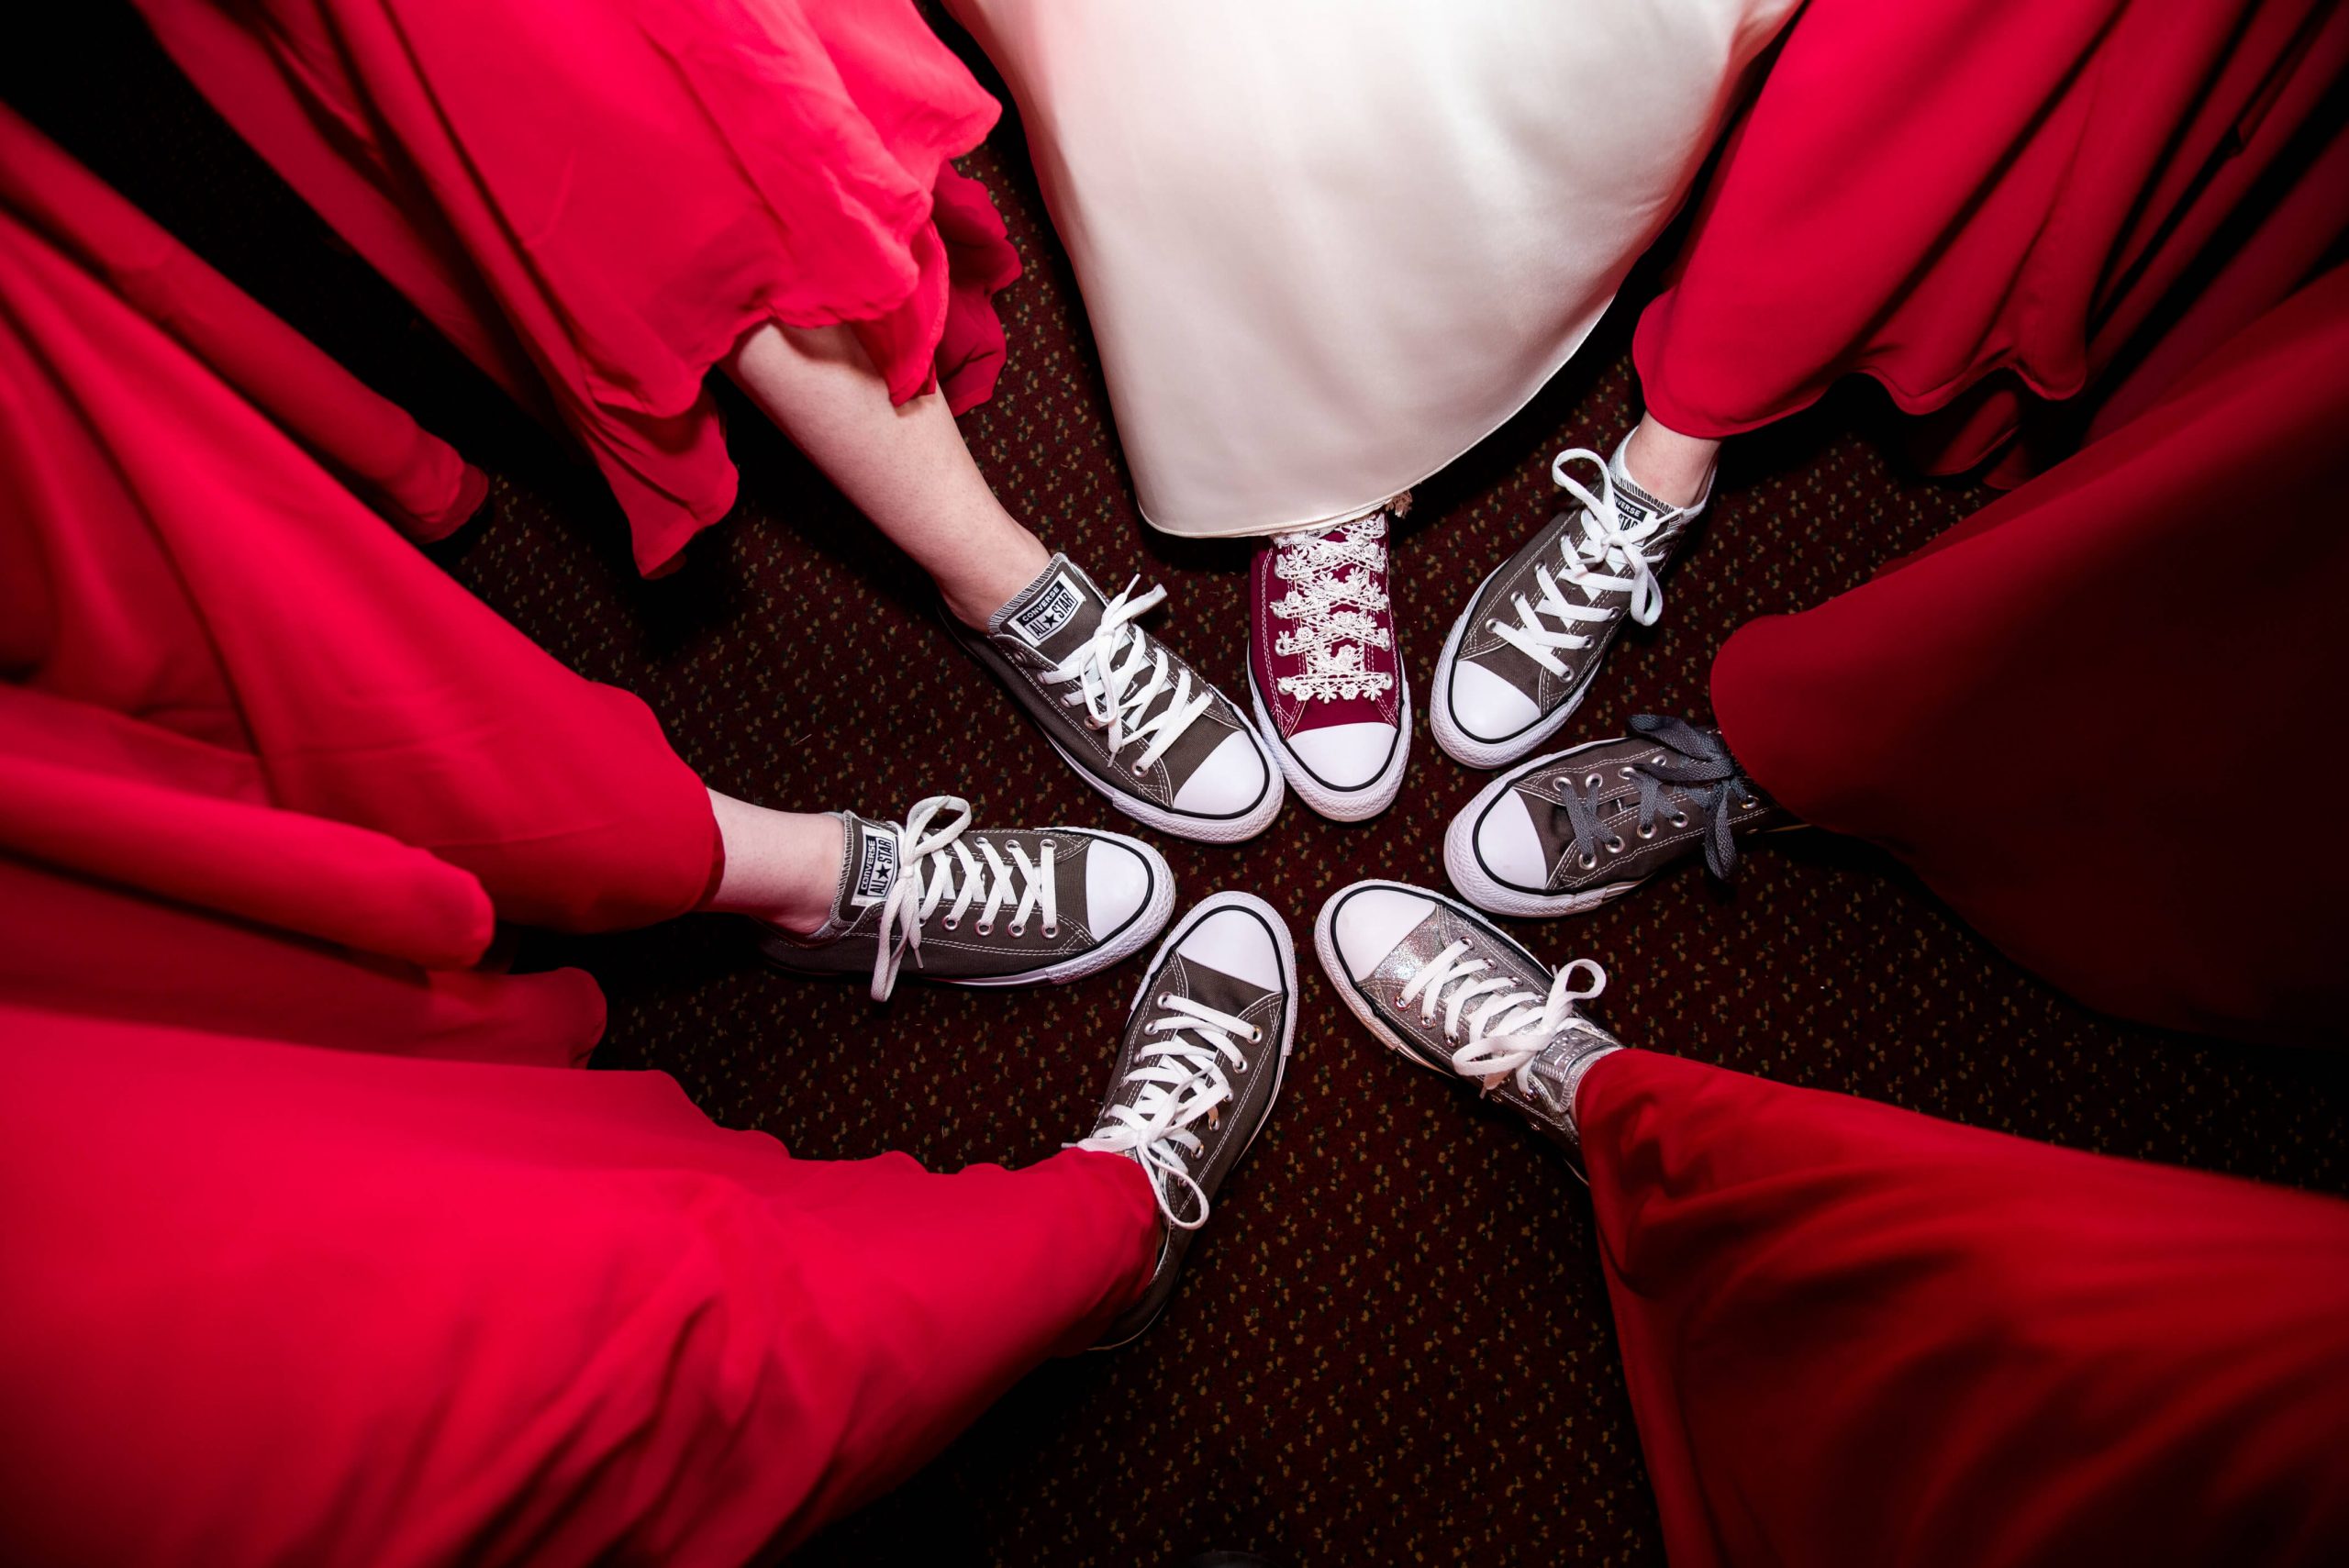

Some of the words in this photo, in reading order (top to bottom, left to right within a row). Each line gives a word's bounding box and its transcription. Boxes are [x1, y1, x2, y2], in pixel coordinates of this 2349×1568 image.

[1615, 495, 1642, 517] NVERSE
[1022, 585, 1060, 622] CONVERSE
[1029, 619, 1051, 637] ALL
[1052, 592, 1074, 618] STAR
[861, 840, 875, 891] CONVERSE
[877, 839, 893, 864] STAR
[870, 879, 888, 895] ALL
